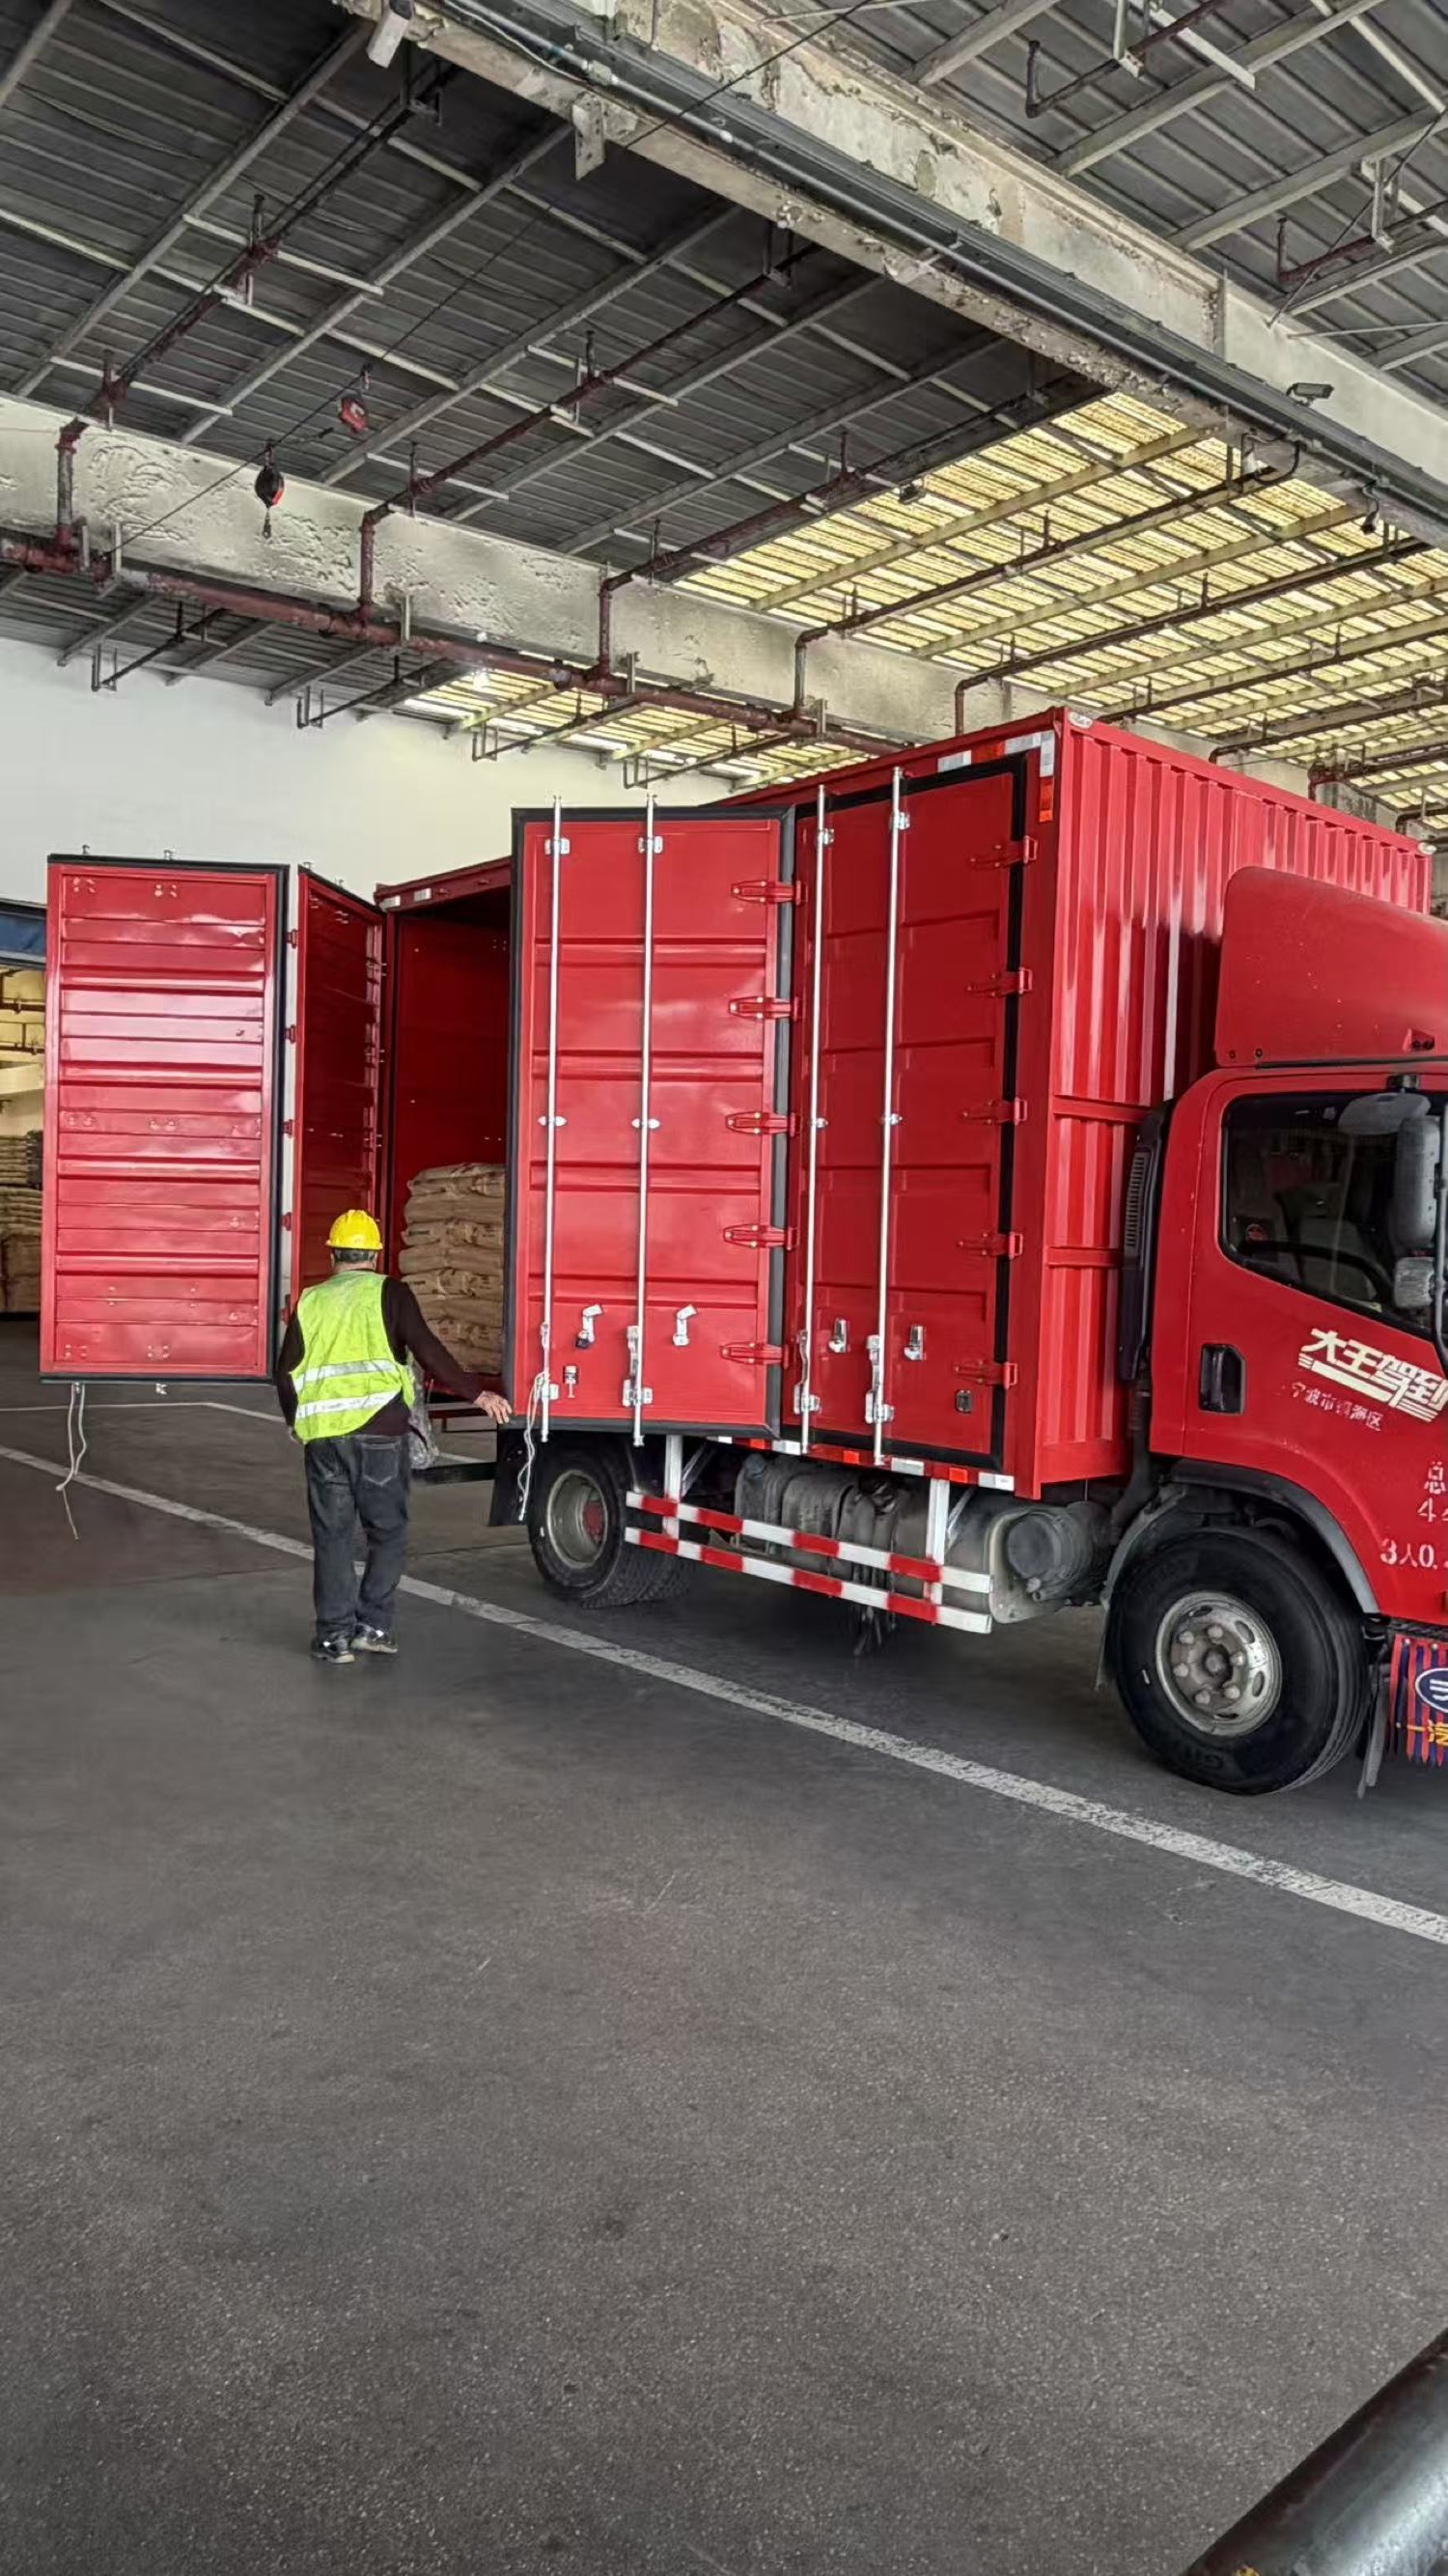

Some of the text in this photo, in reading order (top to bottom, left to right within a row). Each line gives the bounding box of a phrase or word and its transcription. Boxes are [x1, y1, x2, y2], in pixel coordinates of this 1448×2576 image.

[1299, 1328, 1448, 1412] 大王驾到
[1379, 1538, 1448, 1570] 3人0.
